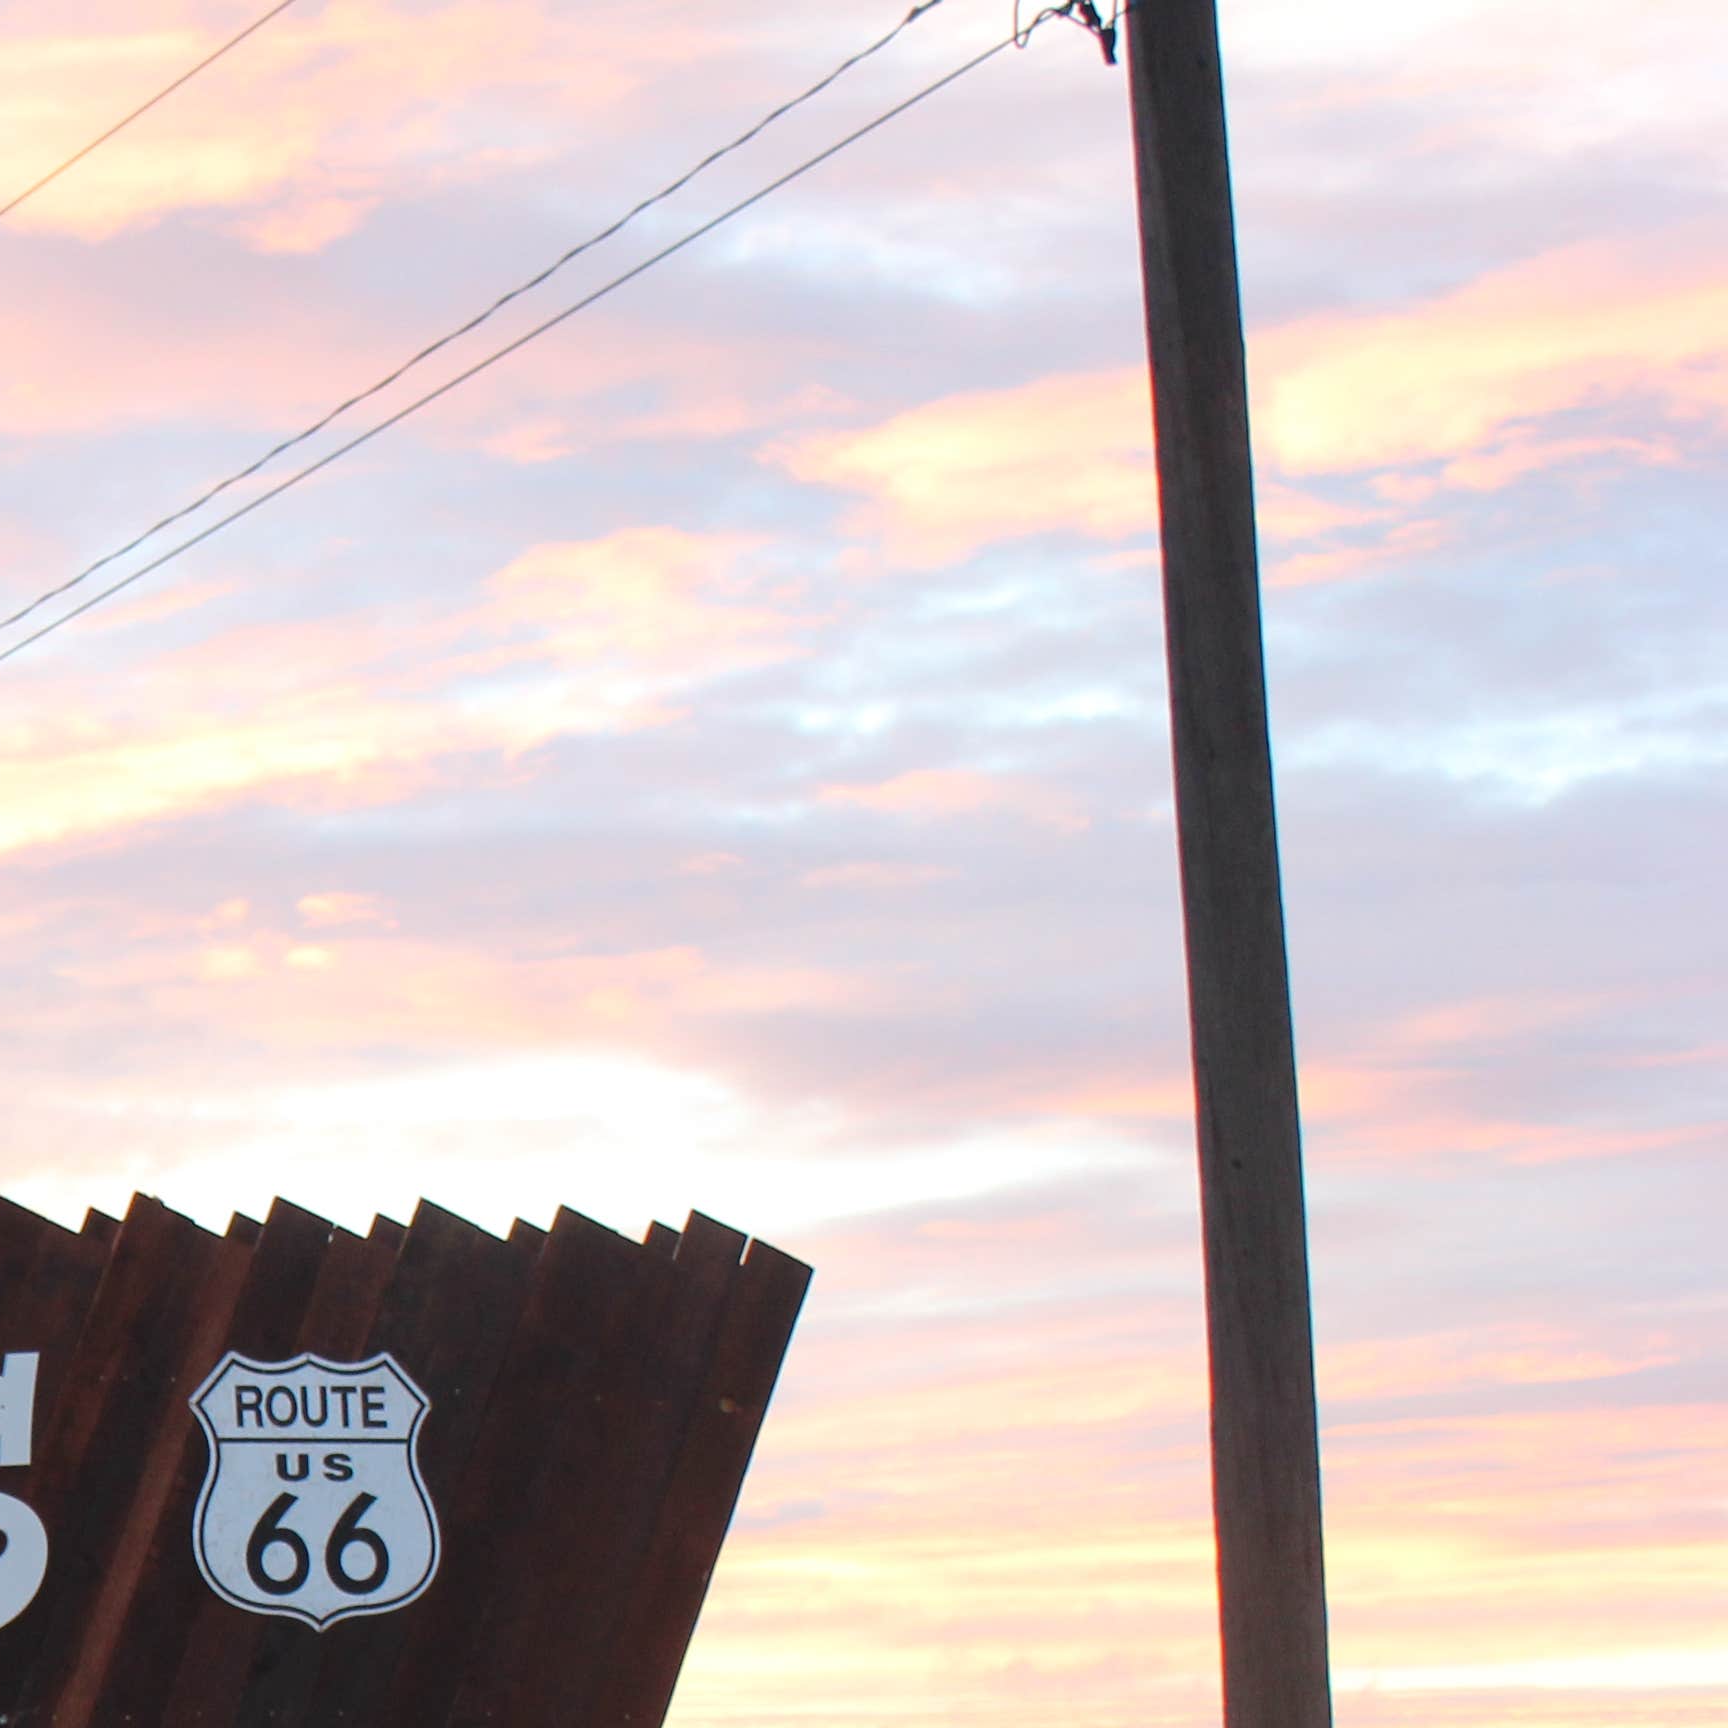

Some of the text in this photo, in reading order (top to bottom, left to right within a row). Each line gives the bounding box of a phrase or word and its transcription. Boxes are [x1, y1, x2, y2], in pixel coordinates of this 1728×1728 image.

[234, 1384, 389, 1429] ROUTE
[275, 1452, 354, 1483] US
[245, 1491, 390, 1596] 66
